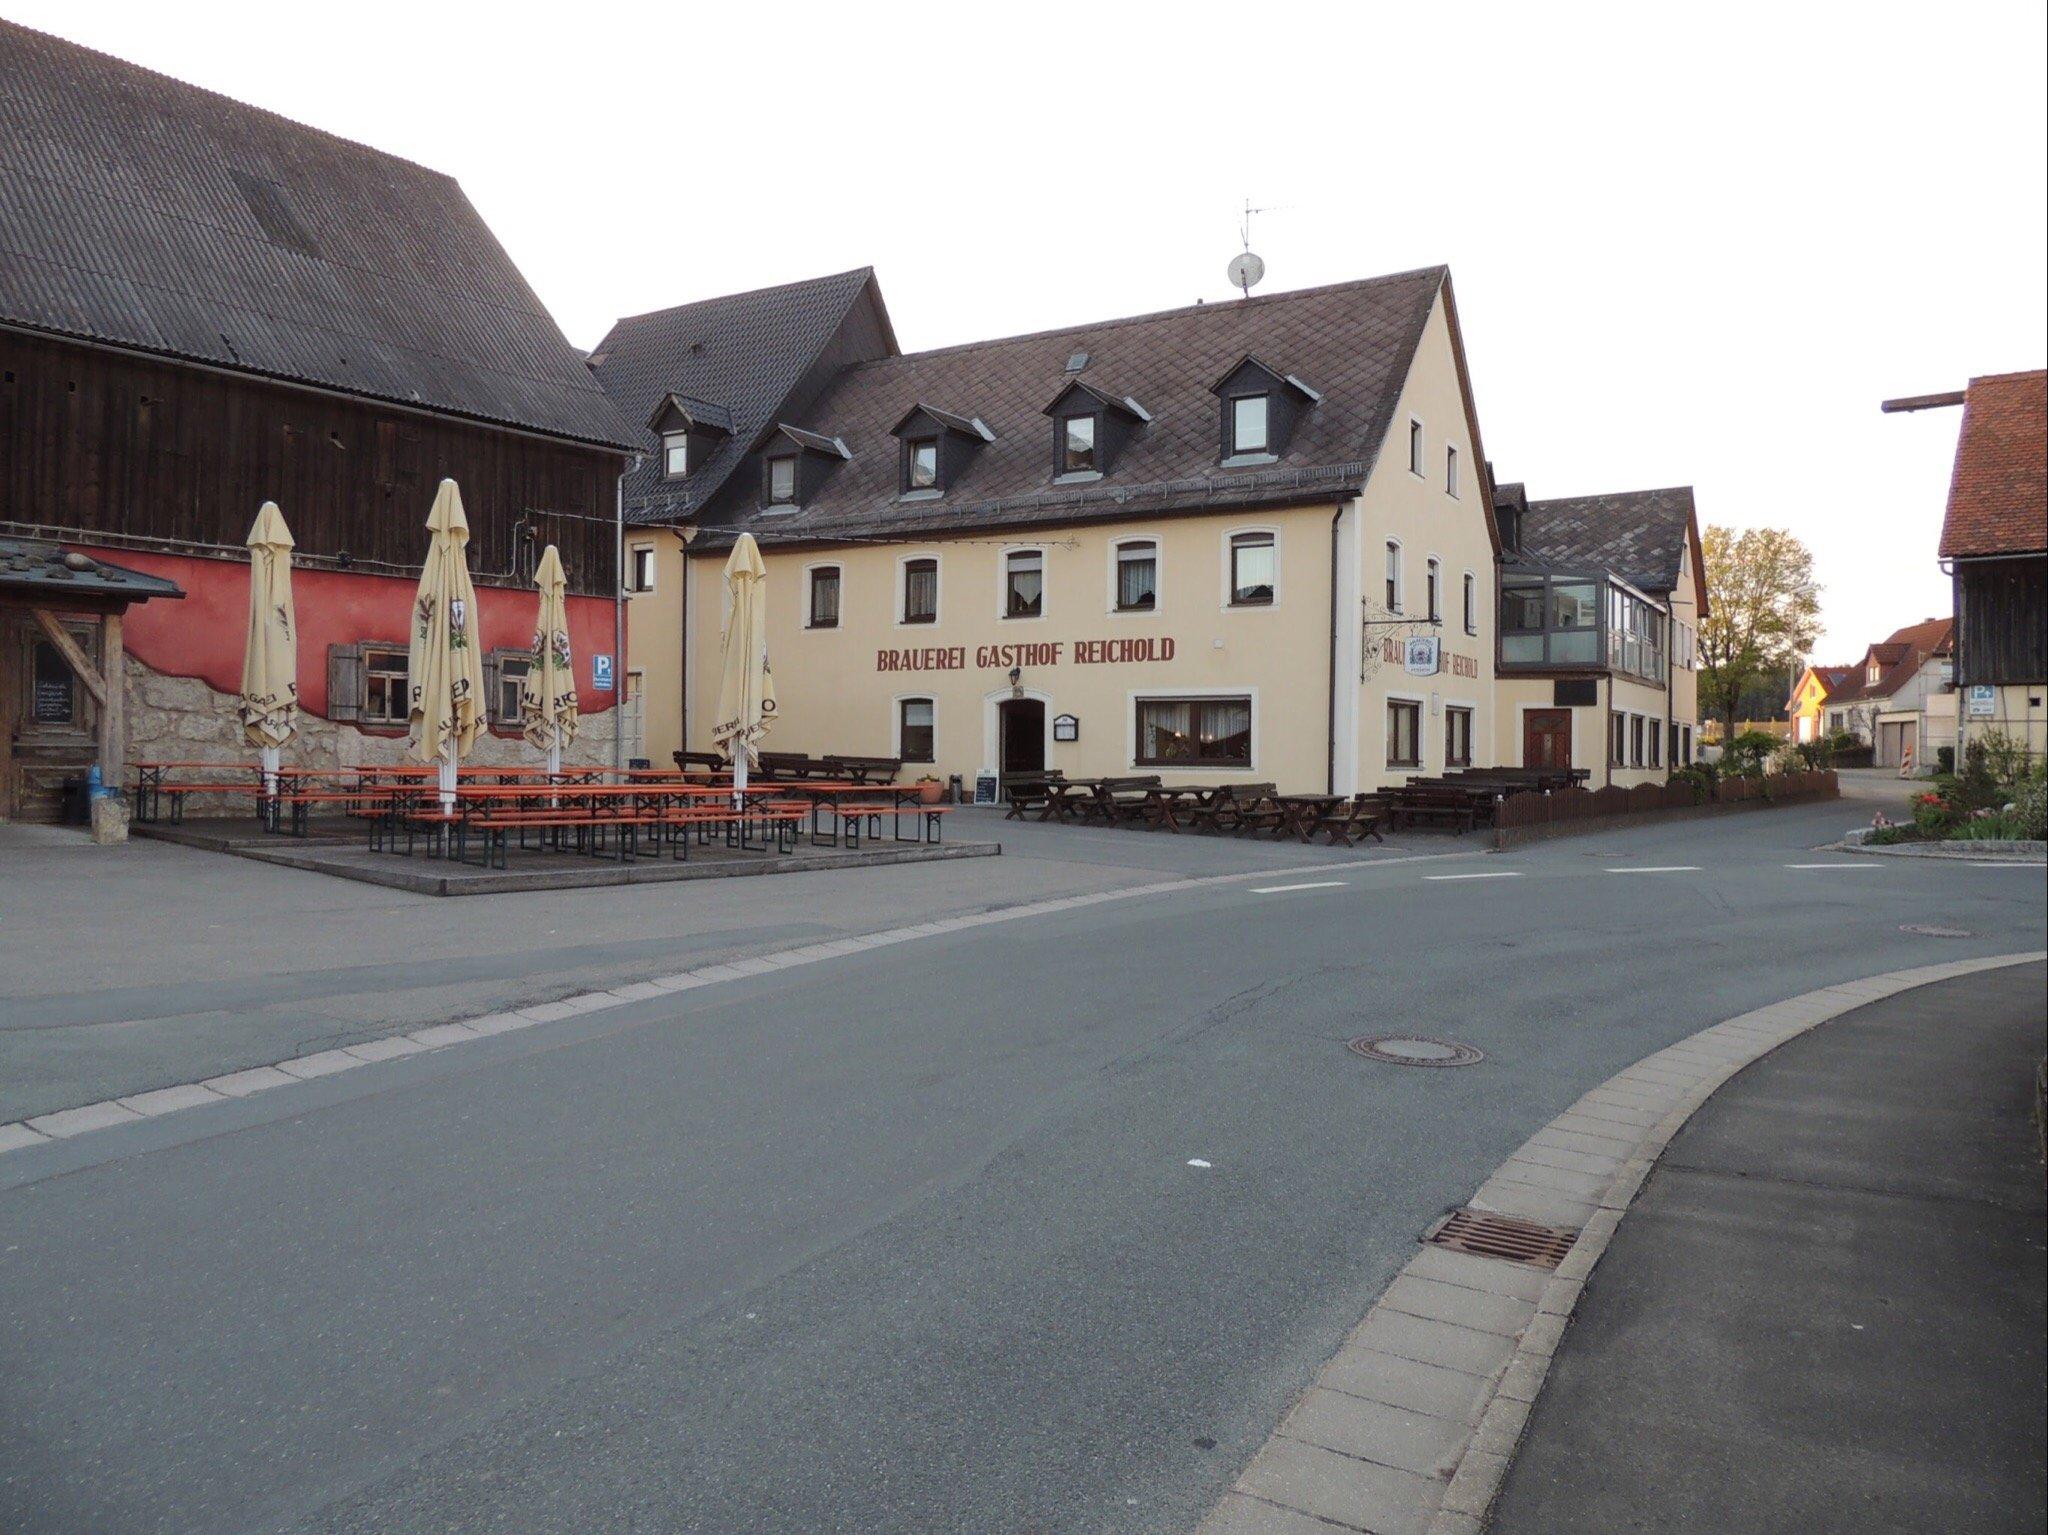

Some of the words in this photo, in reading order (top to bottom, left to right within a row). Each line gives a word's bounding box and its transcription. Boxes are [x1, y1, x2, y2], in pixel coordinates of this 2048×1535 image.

[598, 656, 610, 675] P
[877, 647, 966, 672] BRAUEREI
[976, 642, 1064, 669] GASTHOF
[1074, 637, 1176, 664] REICHOLD
[1453, 653, 1478, 679] REICHOLD
[1974, 685, 1985, 699] P
